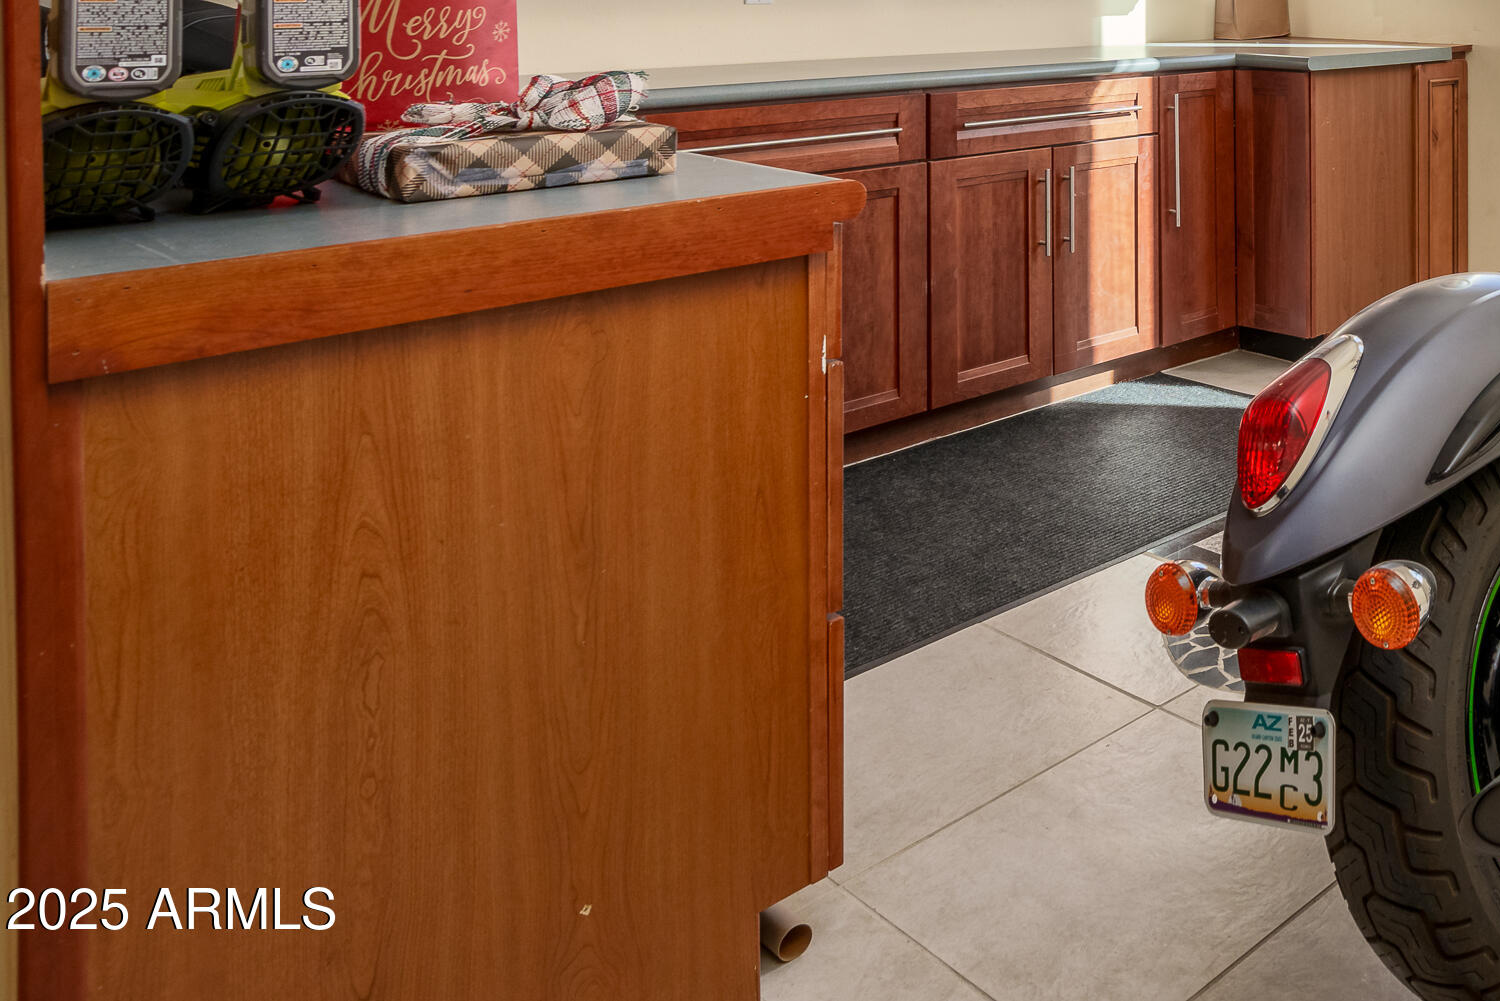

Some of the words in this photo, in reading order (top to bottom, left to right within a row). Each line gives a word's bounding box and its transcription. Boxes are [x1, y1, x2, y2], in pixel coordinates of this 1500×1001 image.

[347, 44, 506, 103] hristmas
[1252, 714, 1282, 732] AZ
[1298, 723, 1314, 743] 25
